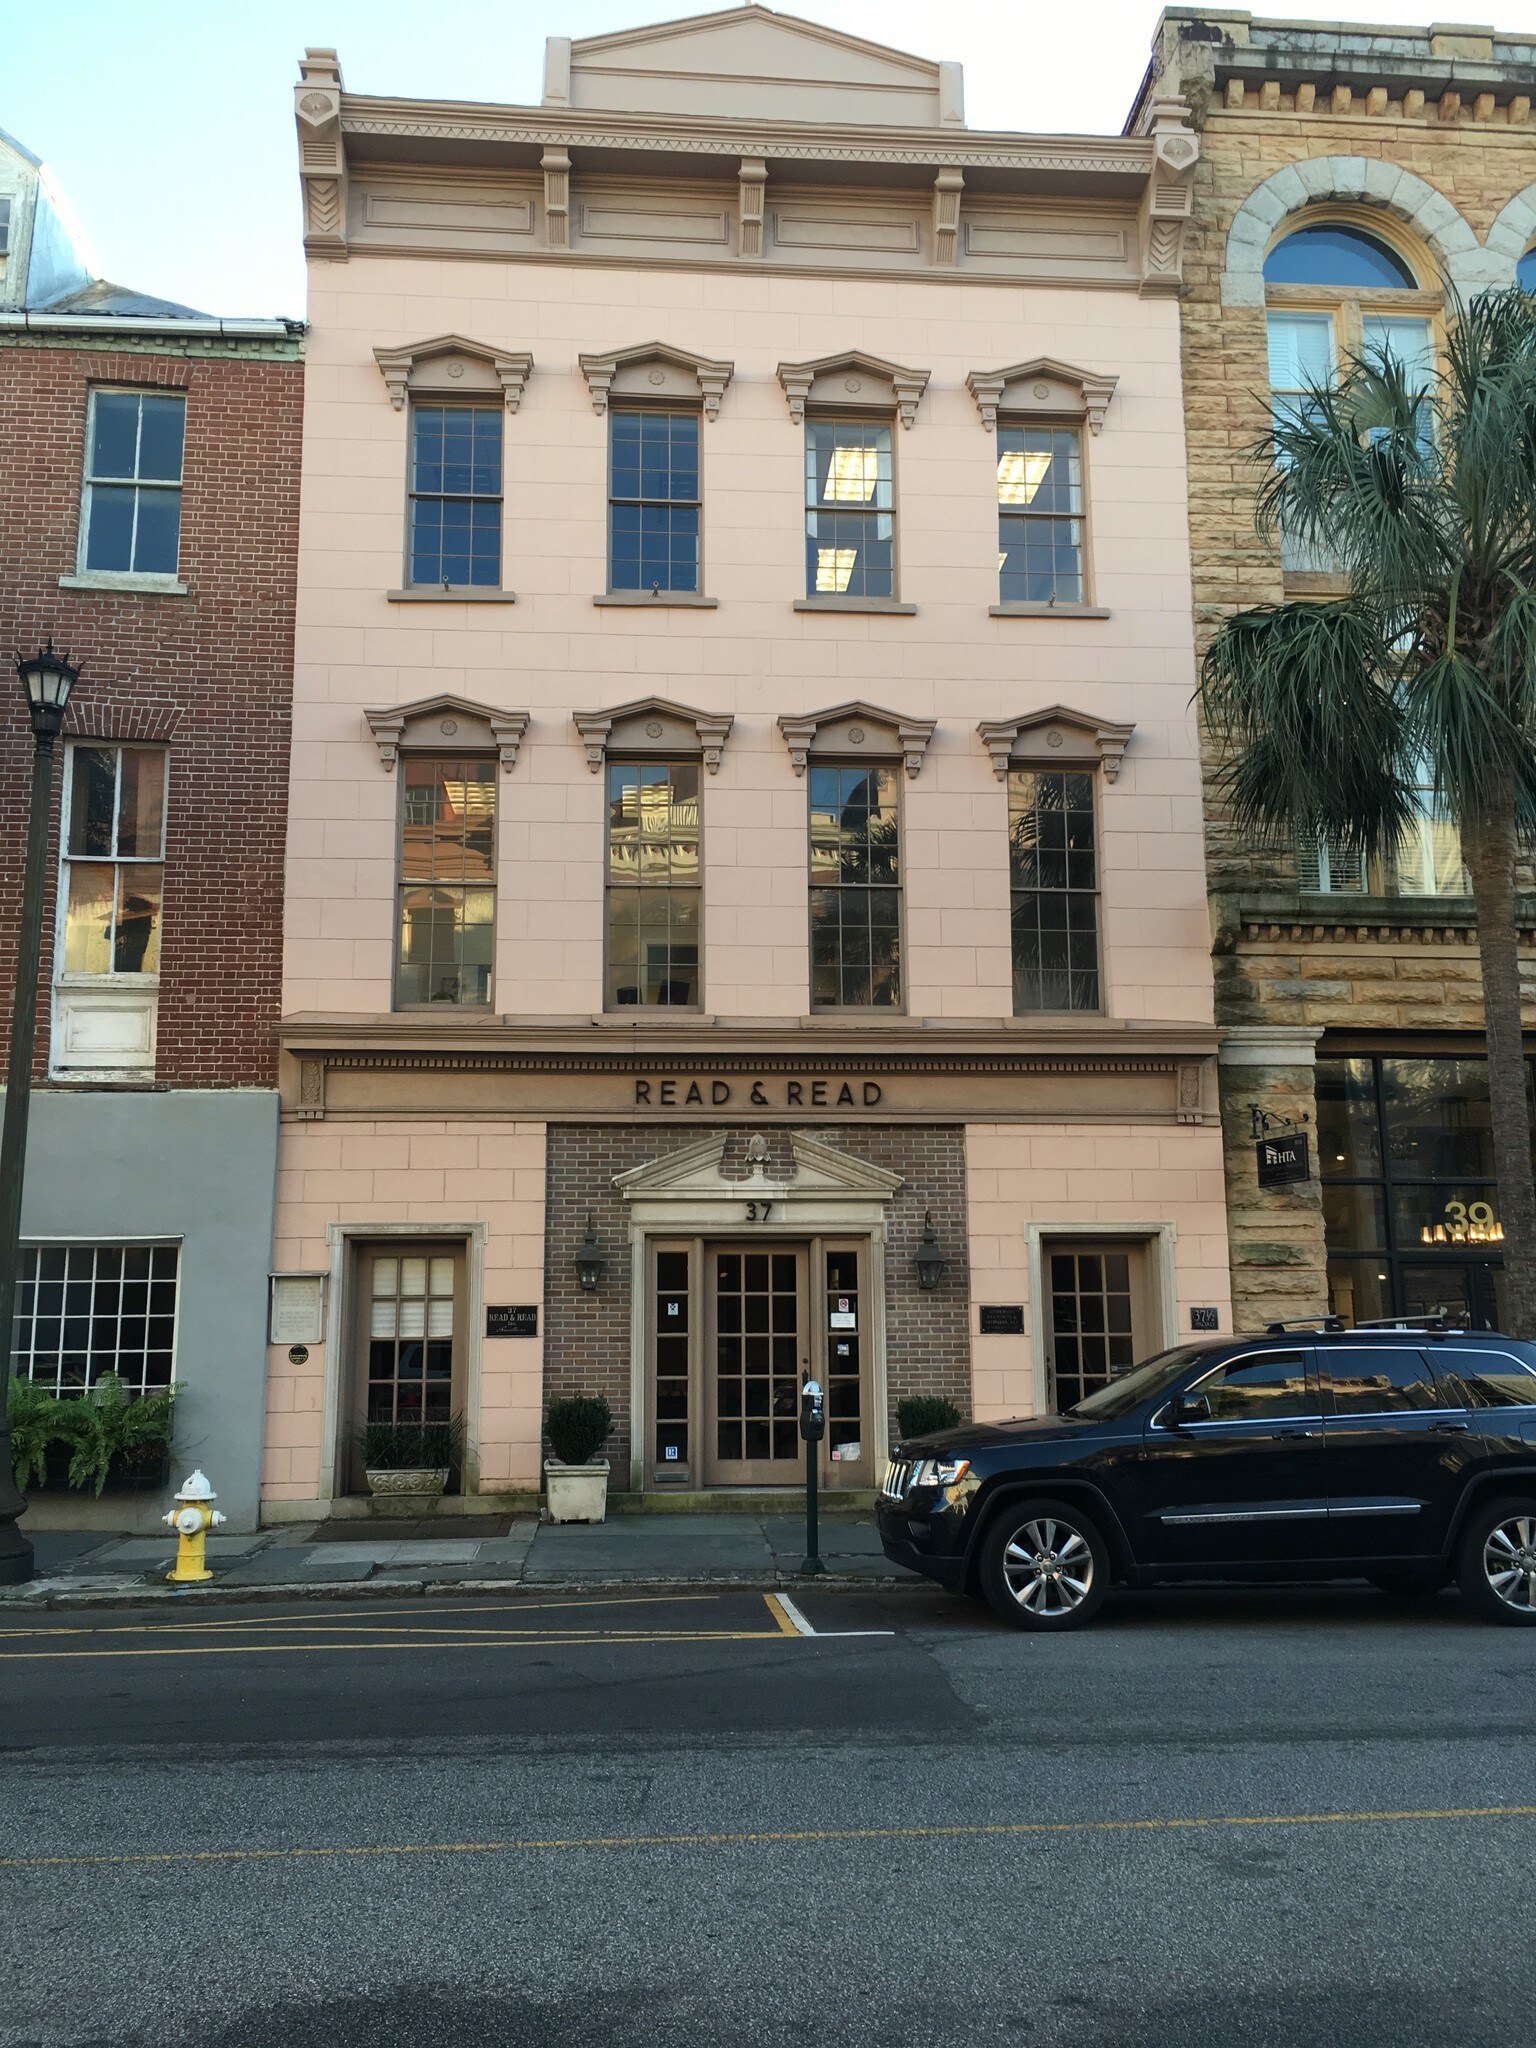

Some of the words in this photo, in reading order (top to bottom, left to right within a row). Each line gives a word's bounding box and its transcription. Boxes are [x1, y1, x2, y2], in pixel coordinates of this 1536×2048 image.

[635, 1080, 730, 1105] READ
[750, 1081, 768, 1105] &
[787, 1081, 882, 1106] READ
[1278, 1150, 1297, 1163] HTA
[746, 1200, 772, 1221] 37
[1444, 1201, 1494, 1235] 39
[489, 1313, 508, 1321] READ
[509, 1313, 516, 1321] &
[517, 1313, 536, 1321] READ
